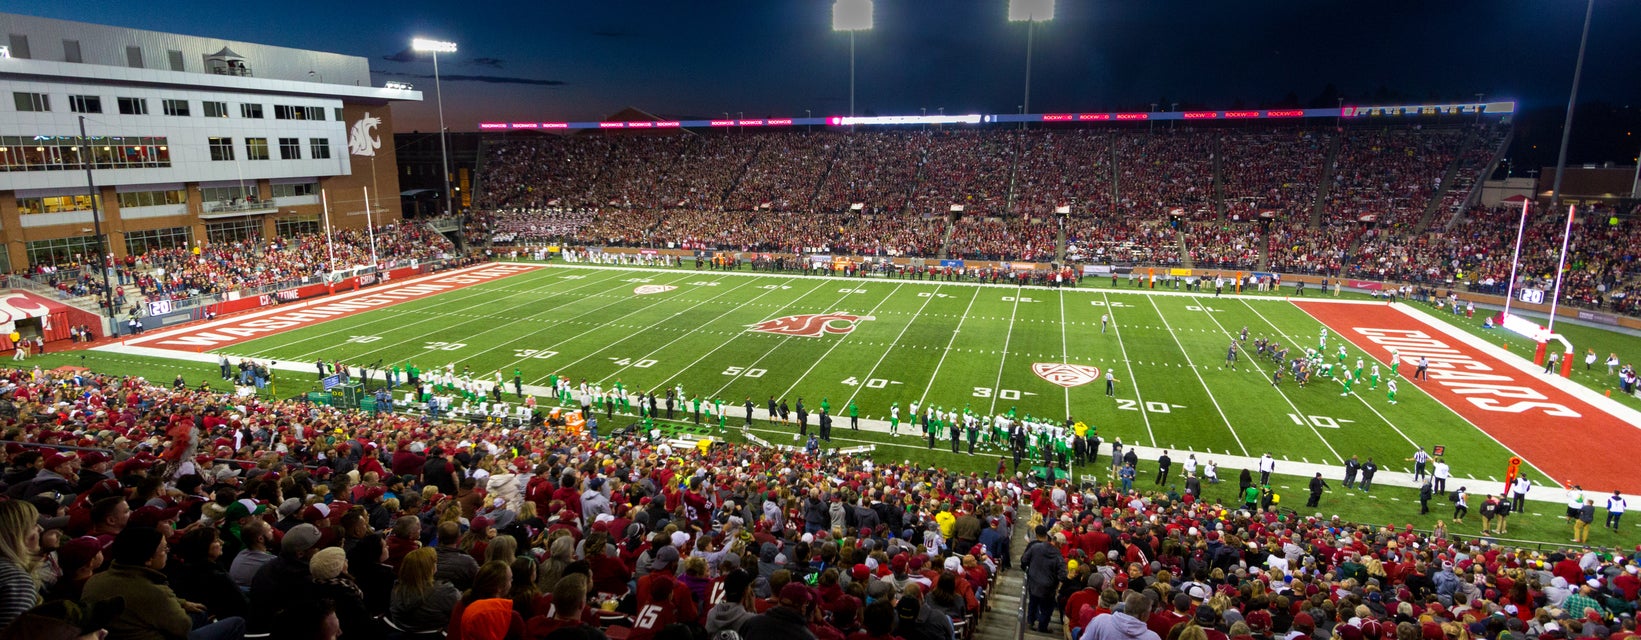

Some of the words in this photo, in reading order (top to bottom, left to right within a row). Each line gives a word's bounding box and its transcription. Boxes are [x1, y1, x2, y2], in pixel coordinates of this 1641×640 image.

[1522, 290, 1541, 303] 20
[152, 301, 169, 315] 20
[156, 283, 454, 346] WASHINGTON
[433, 265, 535, 284] STATE
[424, 342, 468, 352] 20
[515, 349, 560, 359] 30
[612, 358, 660, 368] 40
[720, 366, 769, 378] 50
[1352, 327, 1582, 418] COUGARS
[840, 376, 889, 389] 40
[972, 386, 1022, 401] 30
[1114, 398, 1172, 413] 20
[1287, 413, 1341, 429] 10
[634, 604, 663, 629] 15
